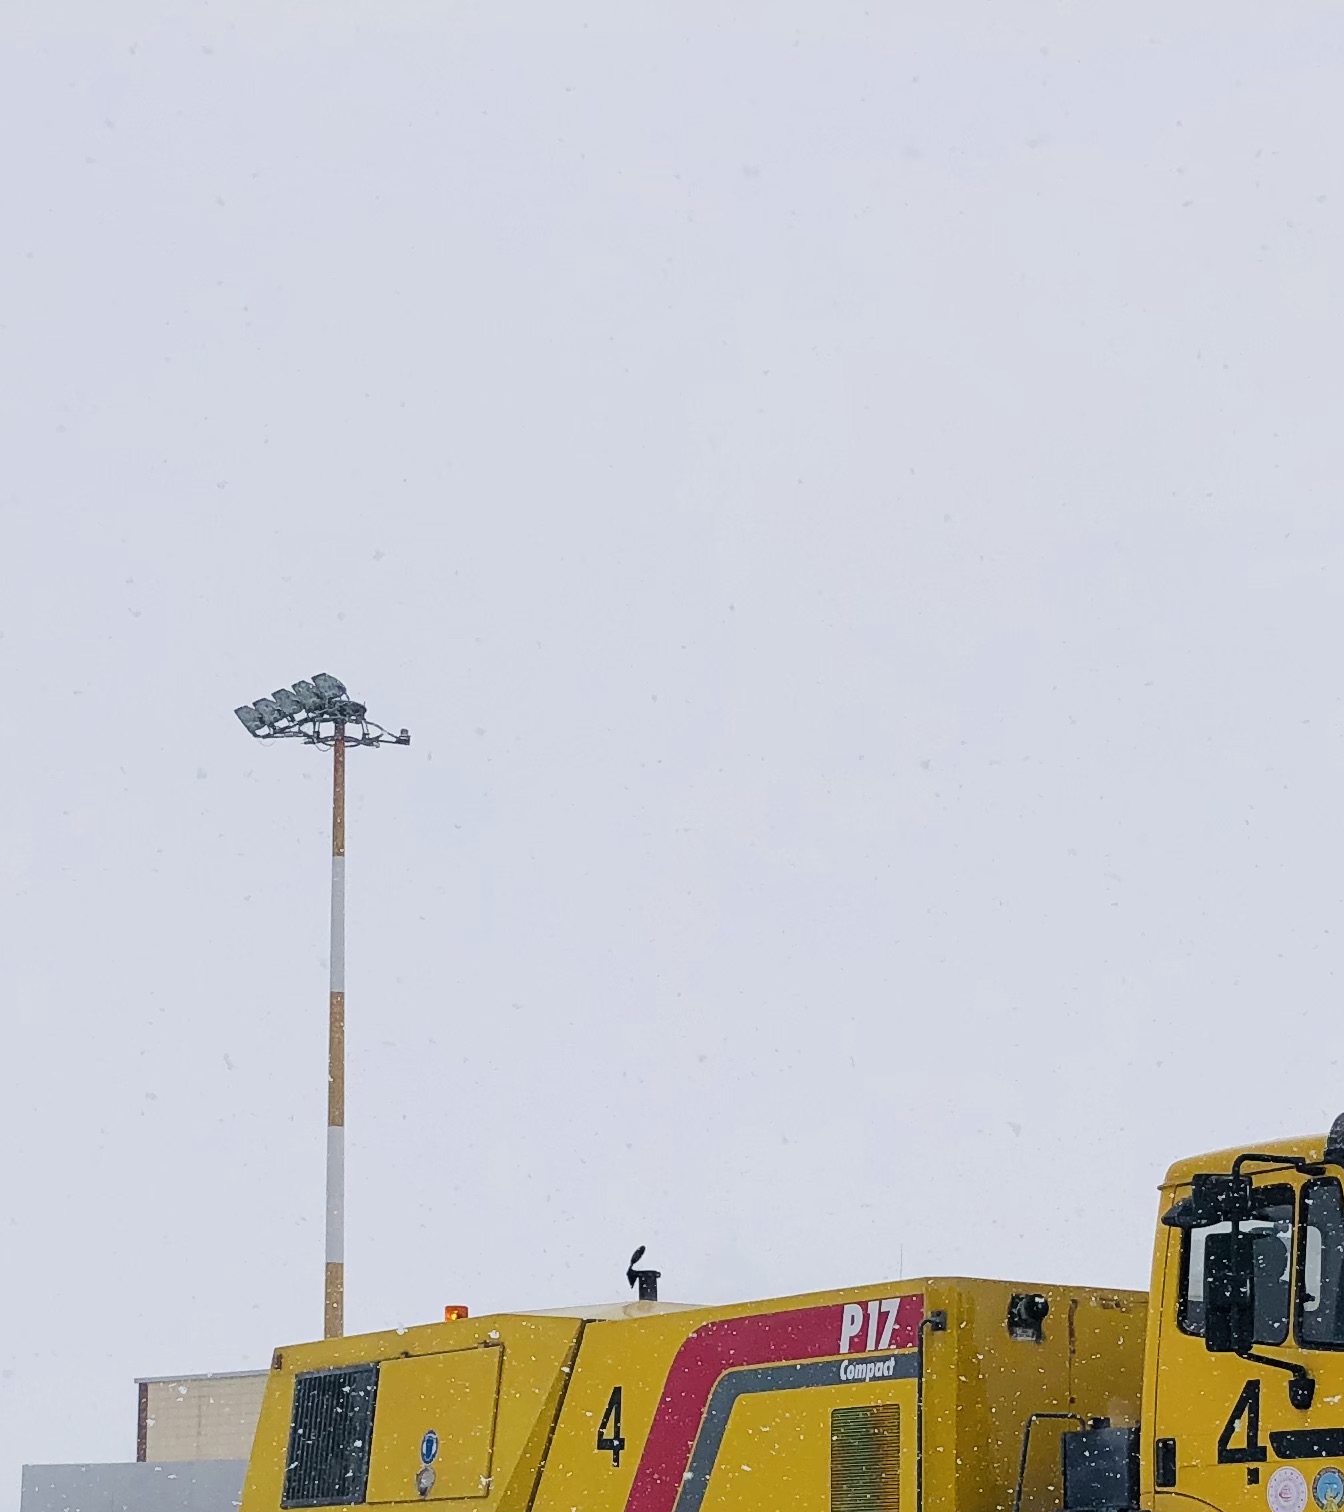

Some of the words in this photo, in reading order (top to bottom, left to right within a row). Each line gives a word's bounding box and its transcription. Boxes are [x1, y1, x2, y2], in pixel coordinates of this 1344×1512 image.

[839, 1298, 901, 1353] P17
[839, 1356, 895, 1382] Compact
[597, 1386, 625, 1467] 4
[1218, 1379, 1267, 1485] 4
